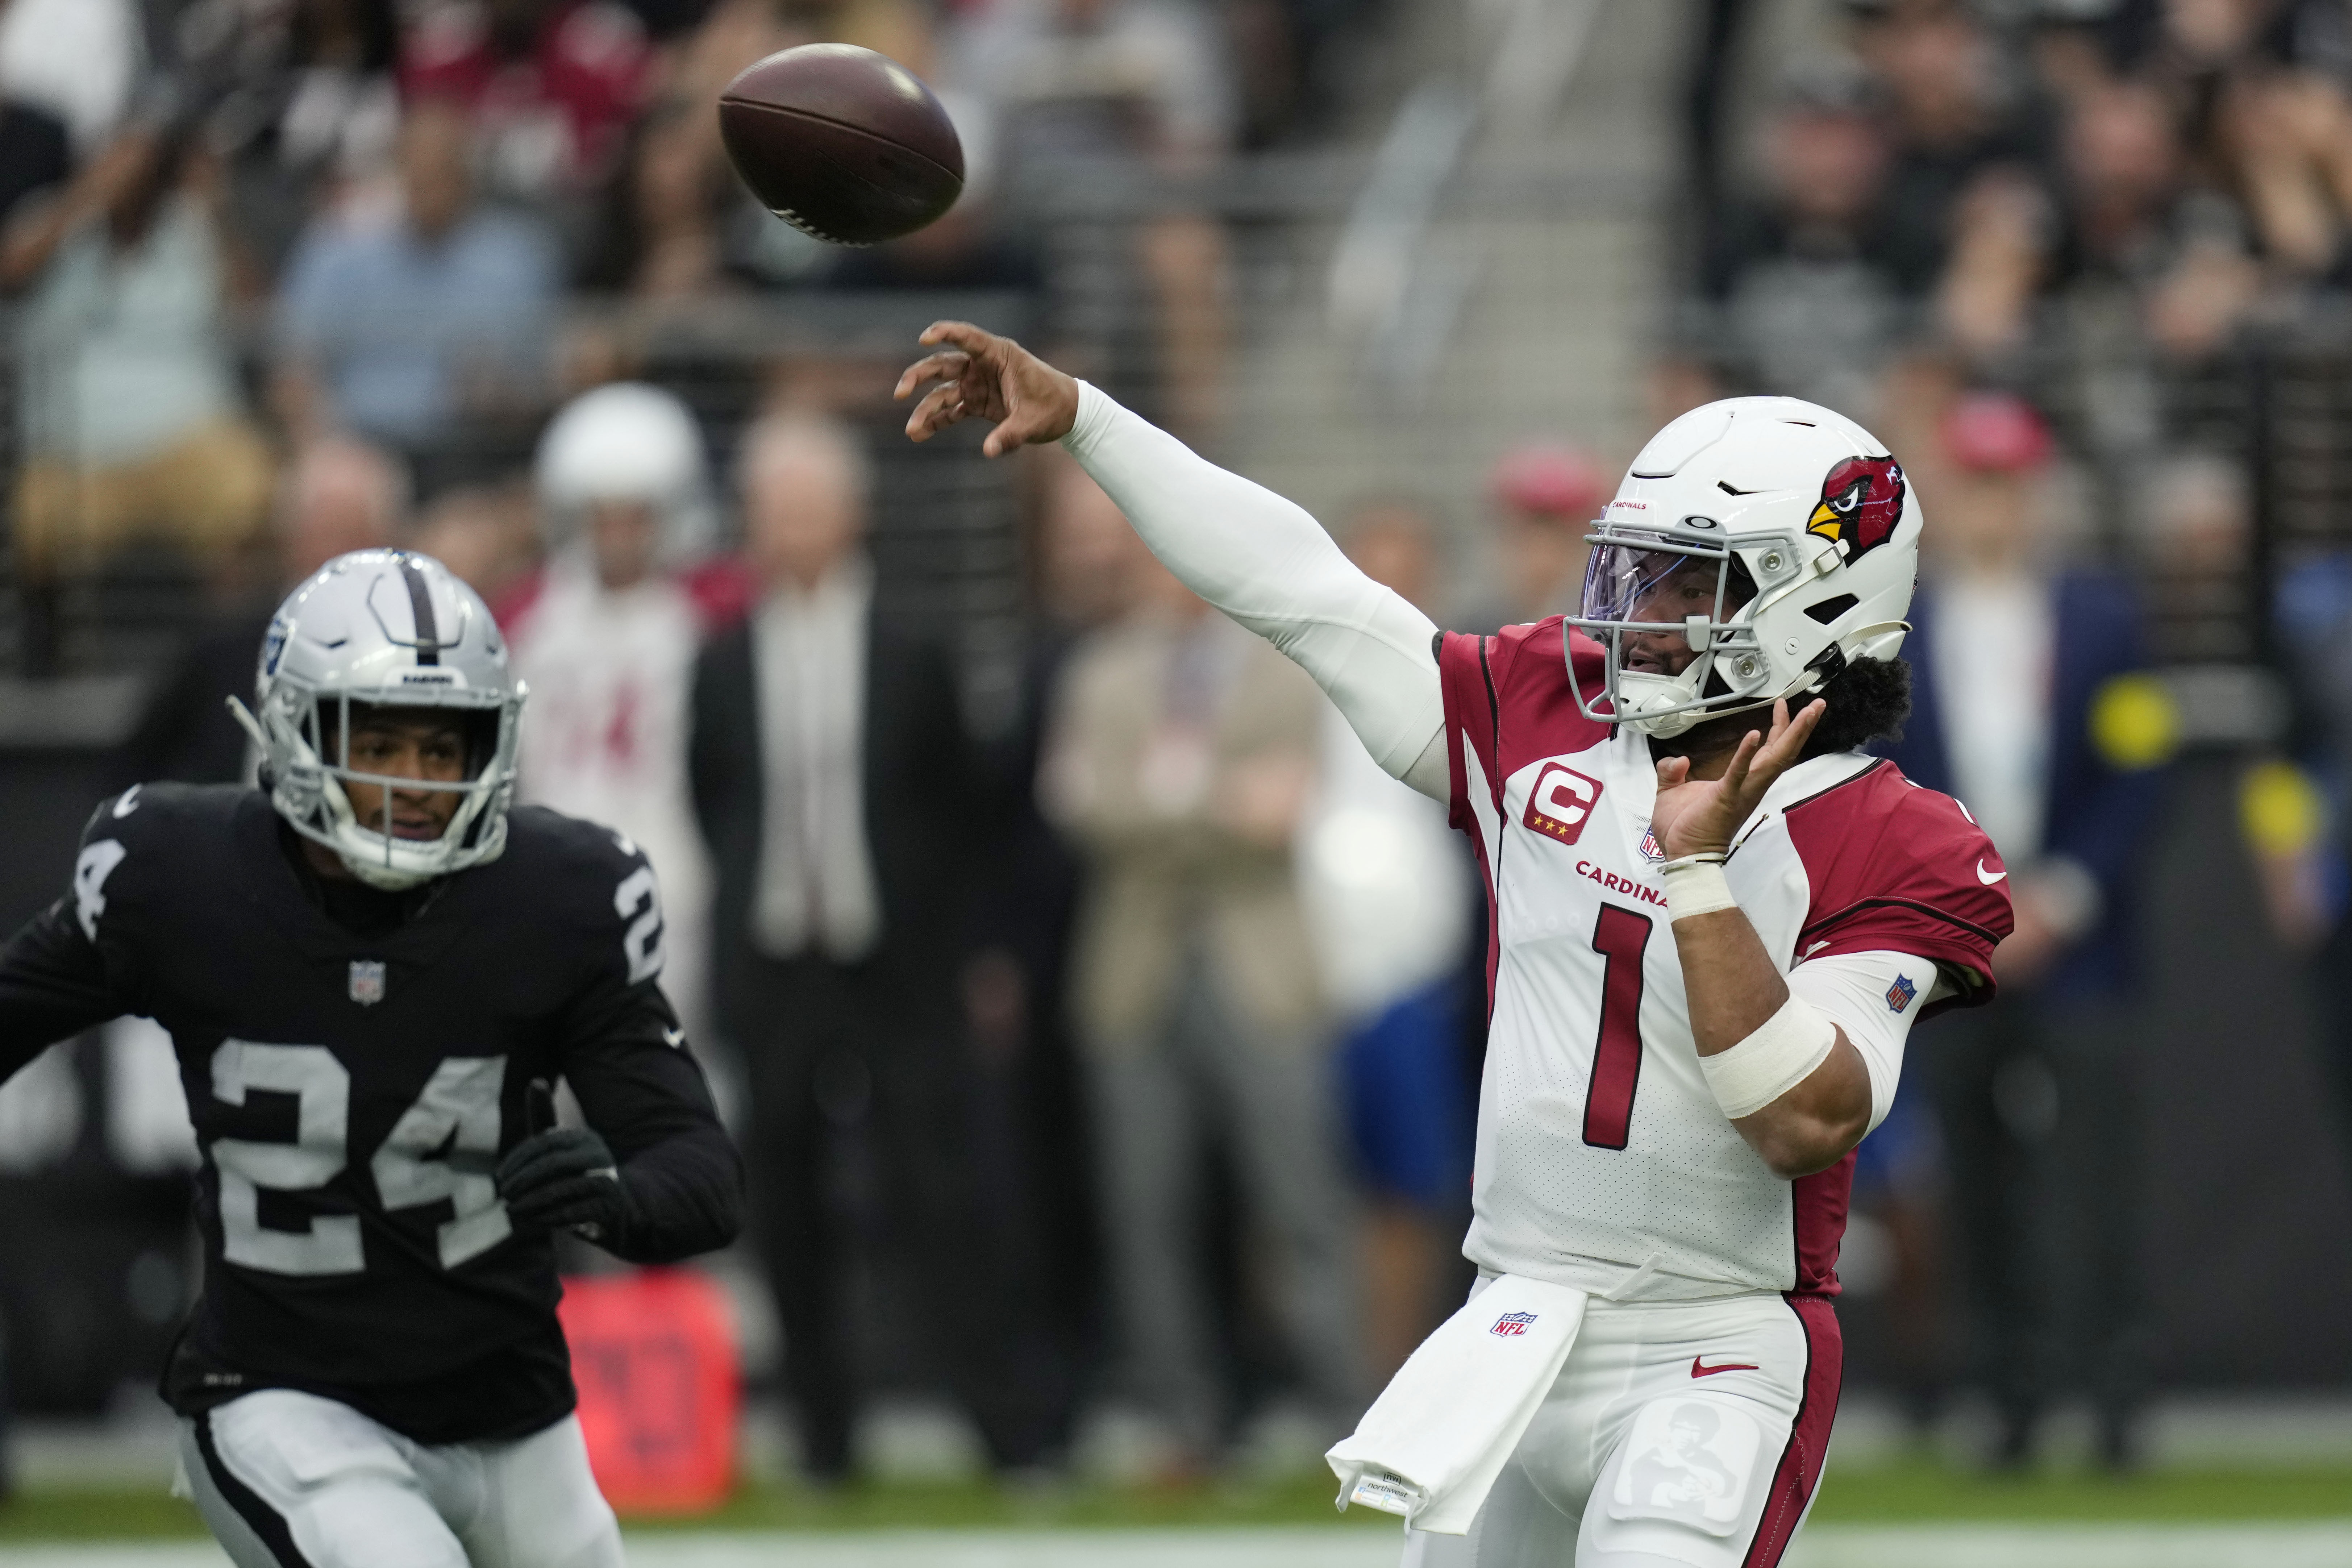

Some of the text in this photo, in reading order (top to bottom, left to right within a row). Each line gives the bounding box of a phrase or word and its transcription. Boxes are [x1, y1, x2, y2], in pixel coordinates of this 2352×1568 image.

[1535, 770, 1594, 824] C
[1889, 985, 1908, 1010] NFL
[1582, 902, 1653, 1151] 1
[210, 1036, 513, 1277] 24
[1494, 1322, 1524, 1335] NFL
[1368, 1482, 1408, 1498] northwest
